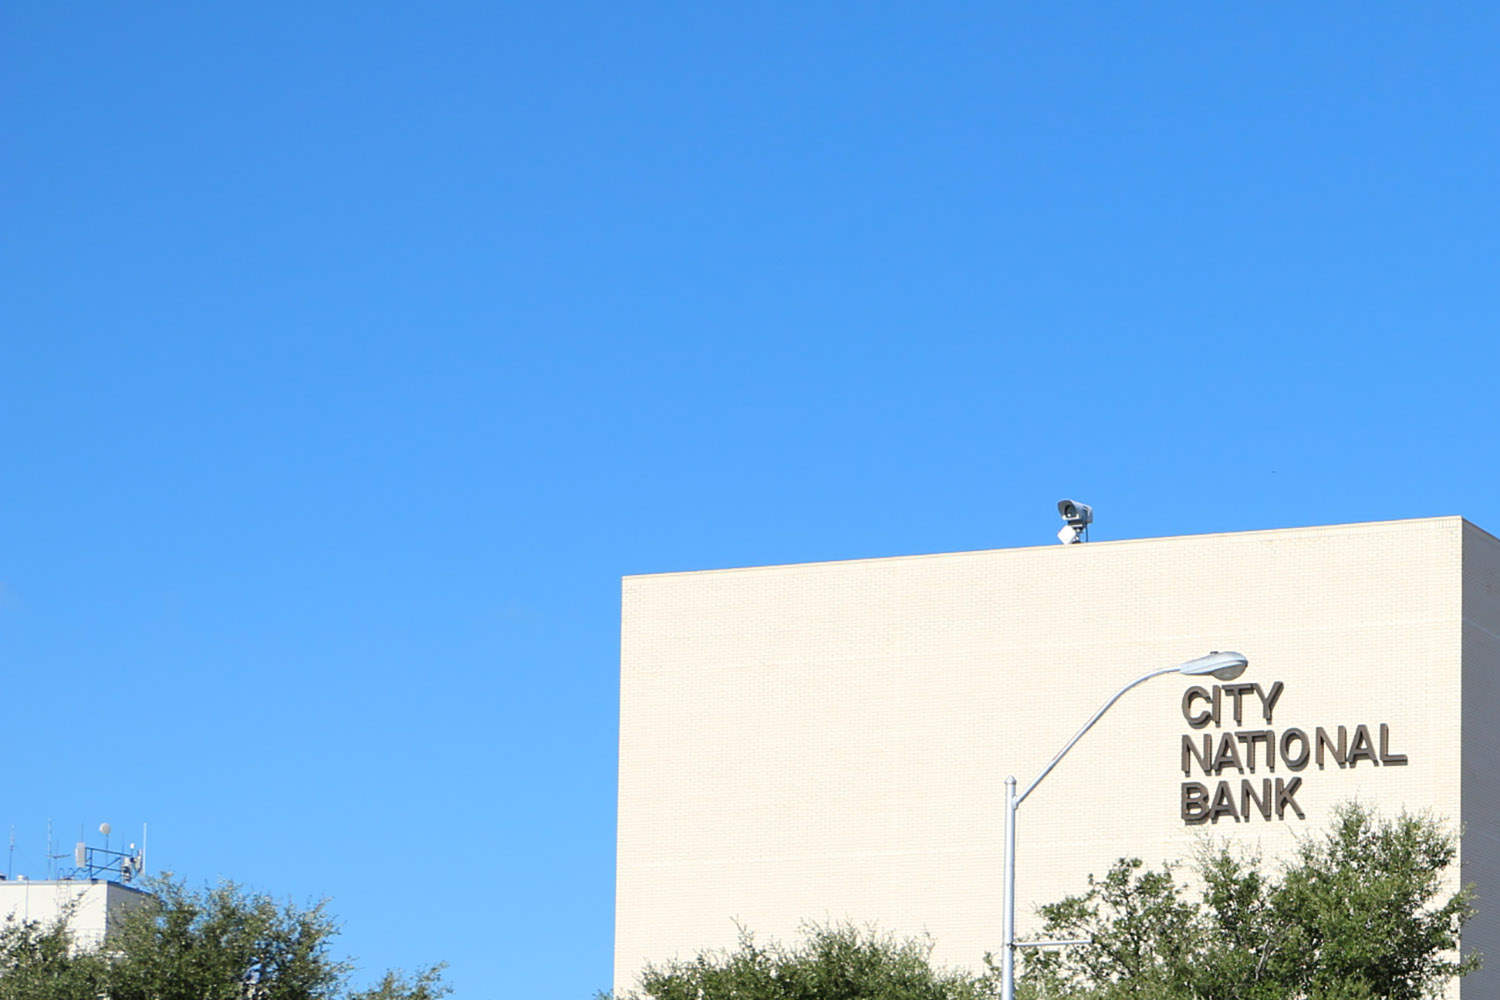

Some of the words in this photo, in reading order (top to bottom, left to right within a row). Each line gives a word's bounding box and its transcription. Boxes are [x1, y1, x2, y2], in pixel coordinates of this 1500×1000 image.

[1182, 681, 1284, 729] CITY
[1181, 723, 1408, 777] NATIONAL
[1181, 776, 1306, 825] BANK
